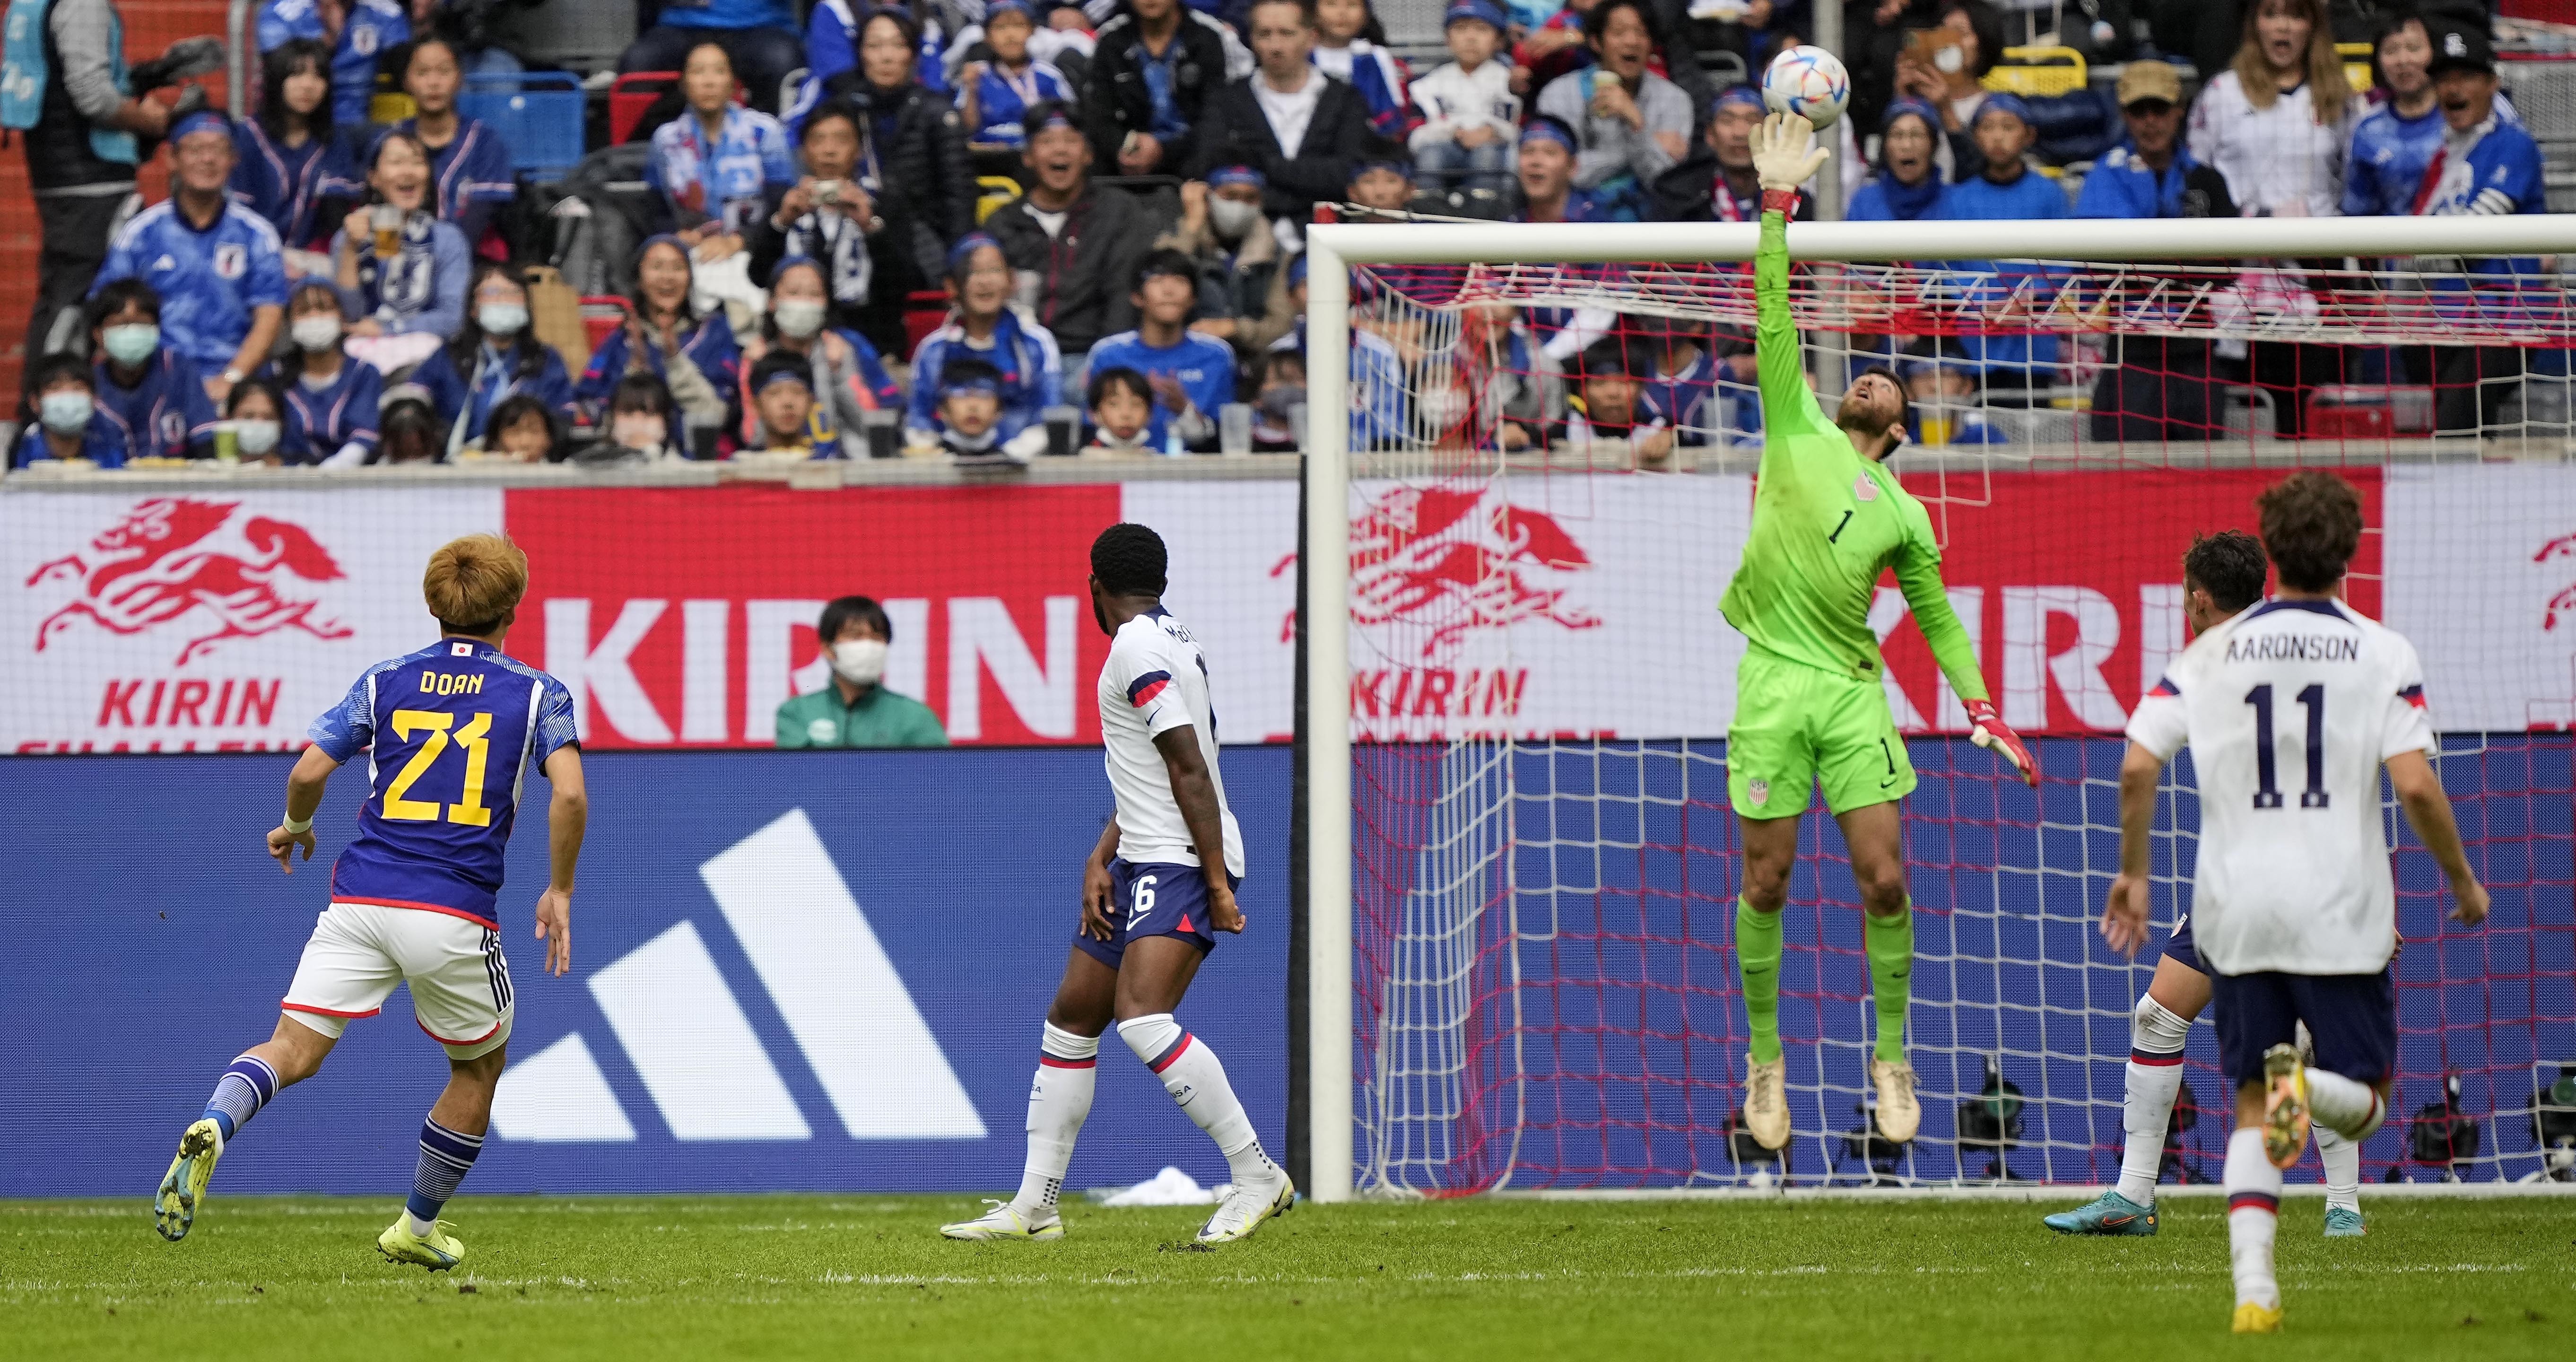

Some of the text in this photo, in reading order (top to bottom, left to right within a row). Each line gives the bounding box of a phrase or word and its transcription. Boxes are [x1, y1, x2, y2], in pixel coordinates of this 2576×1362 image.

[1828, 510, 1853, 544] 1
[544, 596, 1079, 743] KIRIN
[2226, 635, 2358, 661] AARONSON
[97, 678, 282, 727] KIRIN
[419, 671, 484, 696] DOAN
[1349, 667, 1529, 718] KIRIN
[381, 709, 492, 828] 21
[1880, 738, 1896, 775] 1
[2244, 684, 2329, 809] 11
